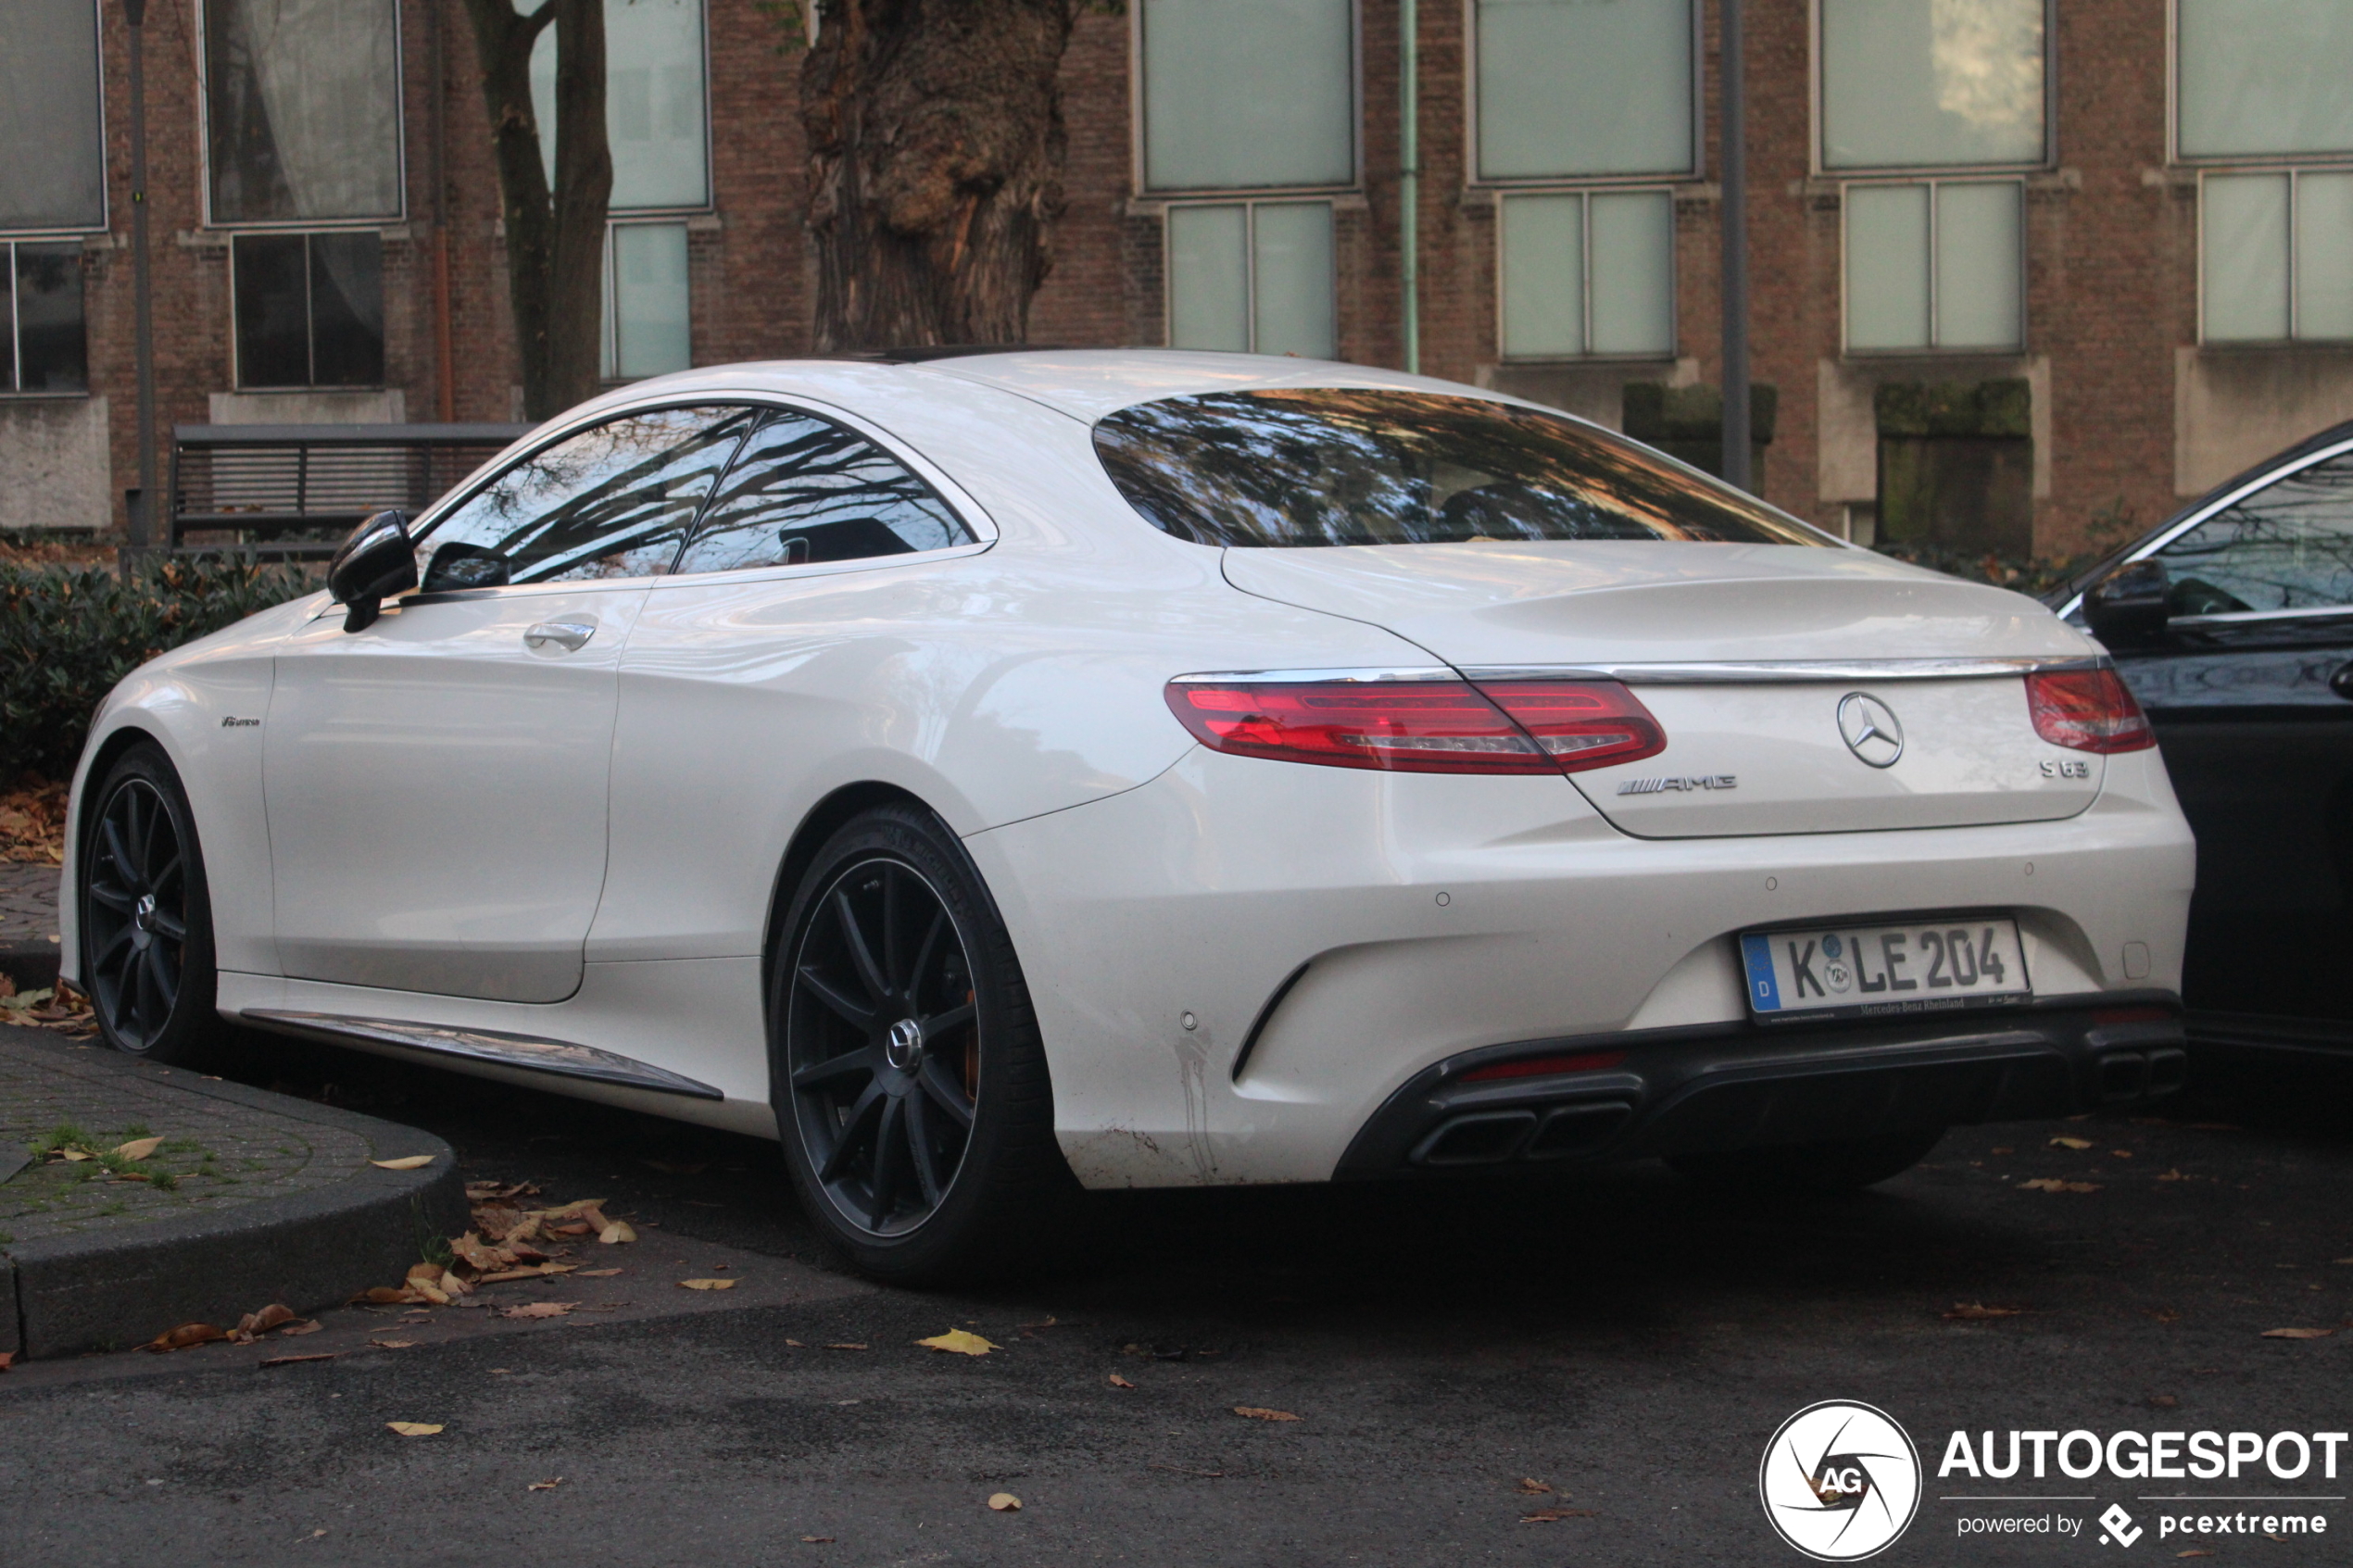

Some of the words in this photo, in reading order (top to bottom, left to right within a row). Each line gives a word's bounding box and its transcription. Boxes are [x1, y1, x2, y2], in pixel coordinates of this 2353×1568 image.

[2039, 760, 2057, 778] S
[2058, 760, 2090, 778] 63
[1655, 775, 1737, 791] AMG
[1788, 939, 1826, 998] K
[1920, 927, 2005, 988] 204
[1759, 980, 1769, 997] D
[1860, 1001, 1923, 1015] Mercedes-Benz
[1923, 997, 1964, 1010] Rheinland
